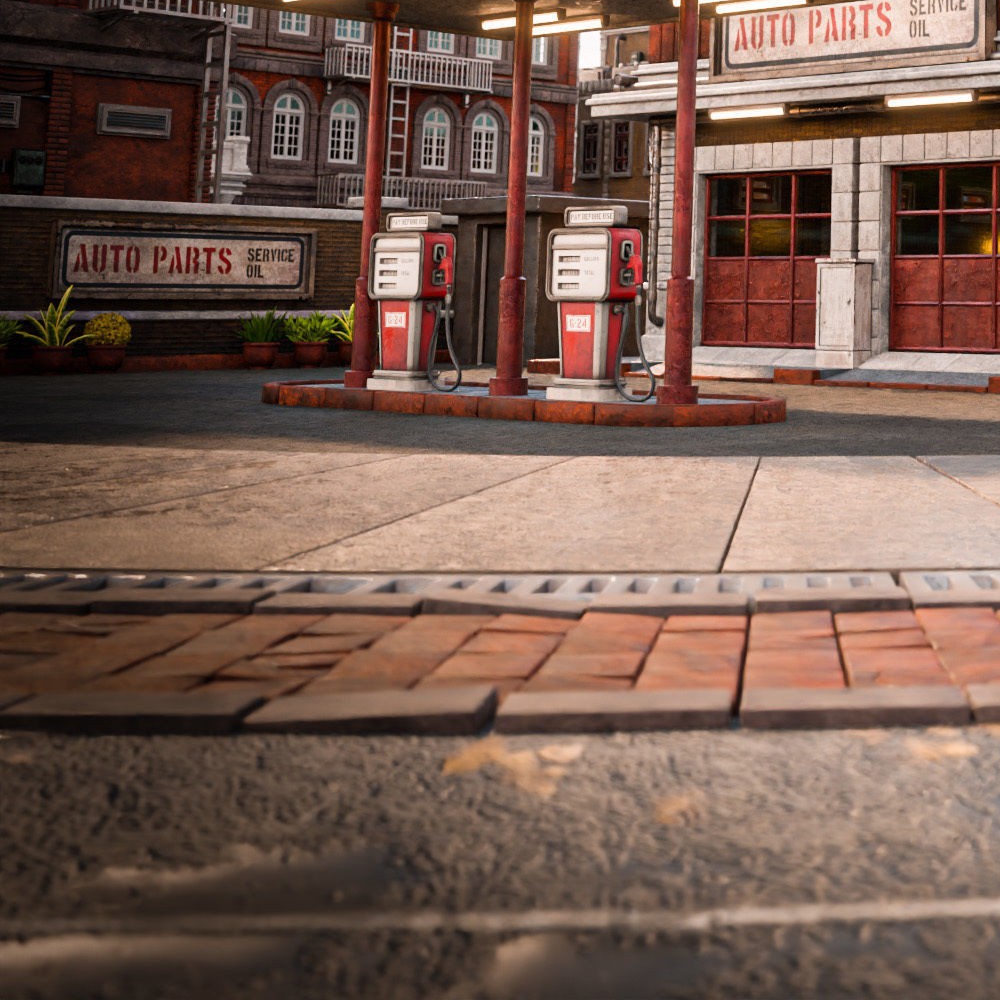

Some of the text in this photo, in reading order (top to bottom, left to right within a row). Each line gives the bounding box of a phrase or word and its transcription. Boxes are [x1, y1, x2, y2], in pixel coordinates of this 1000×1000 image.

[734, 1, 892, 52] AUTO PARTS
[908, 19, 930, 39] OIL
[72, 243, 233, 275] AUTO PARTS
[247, 247, 296, 263] SERVICE
[245, 264, 264, 279] OIL
